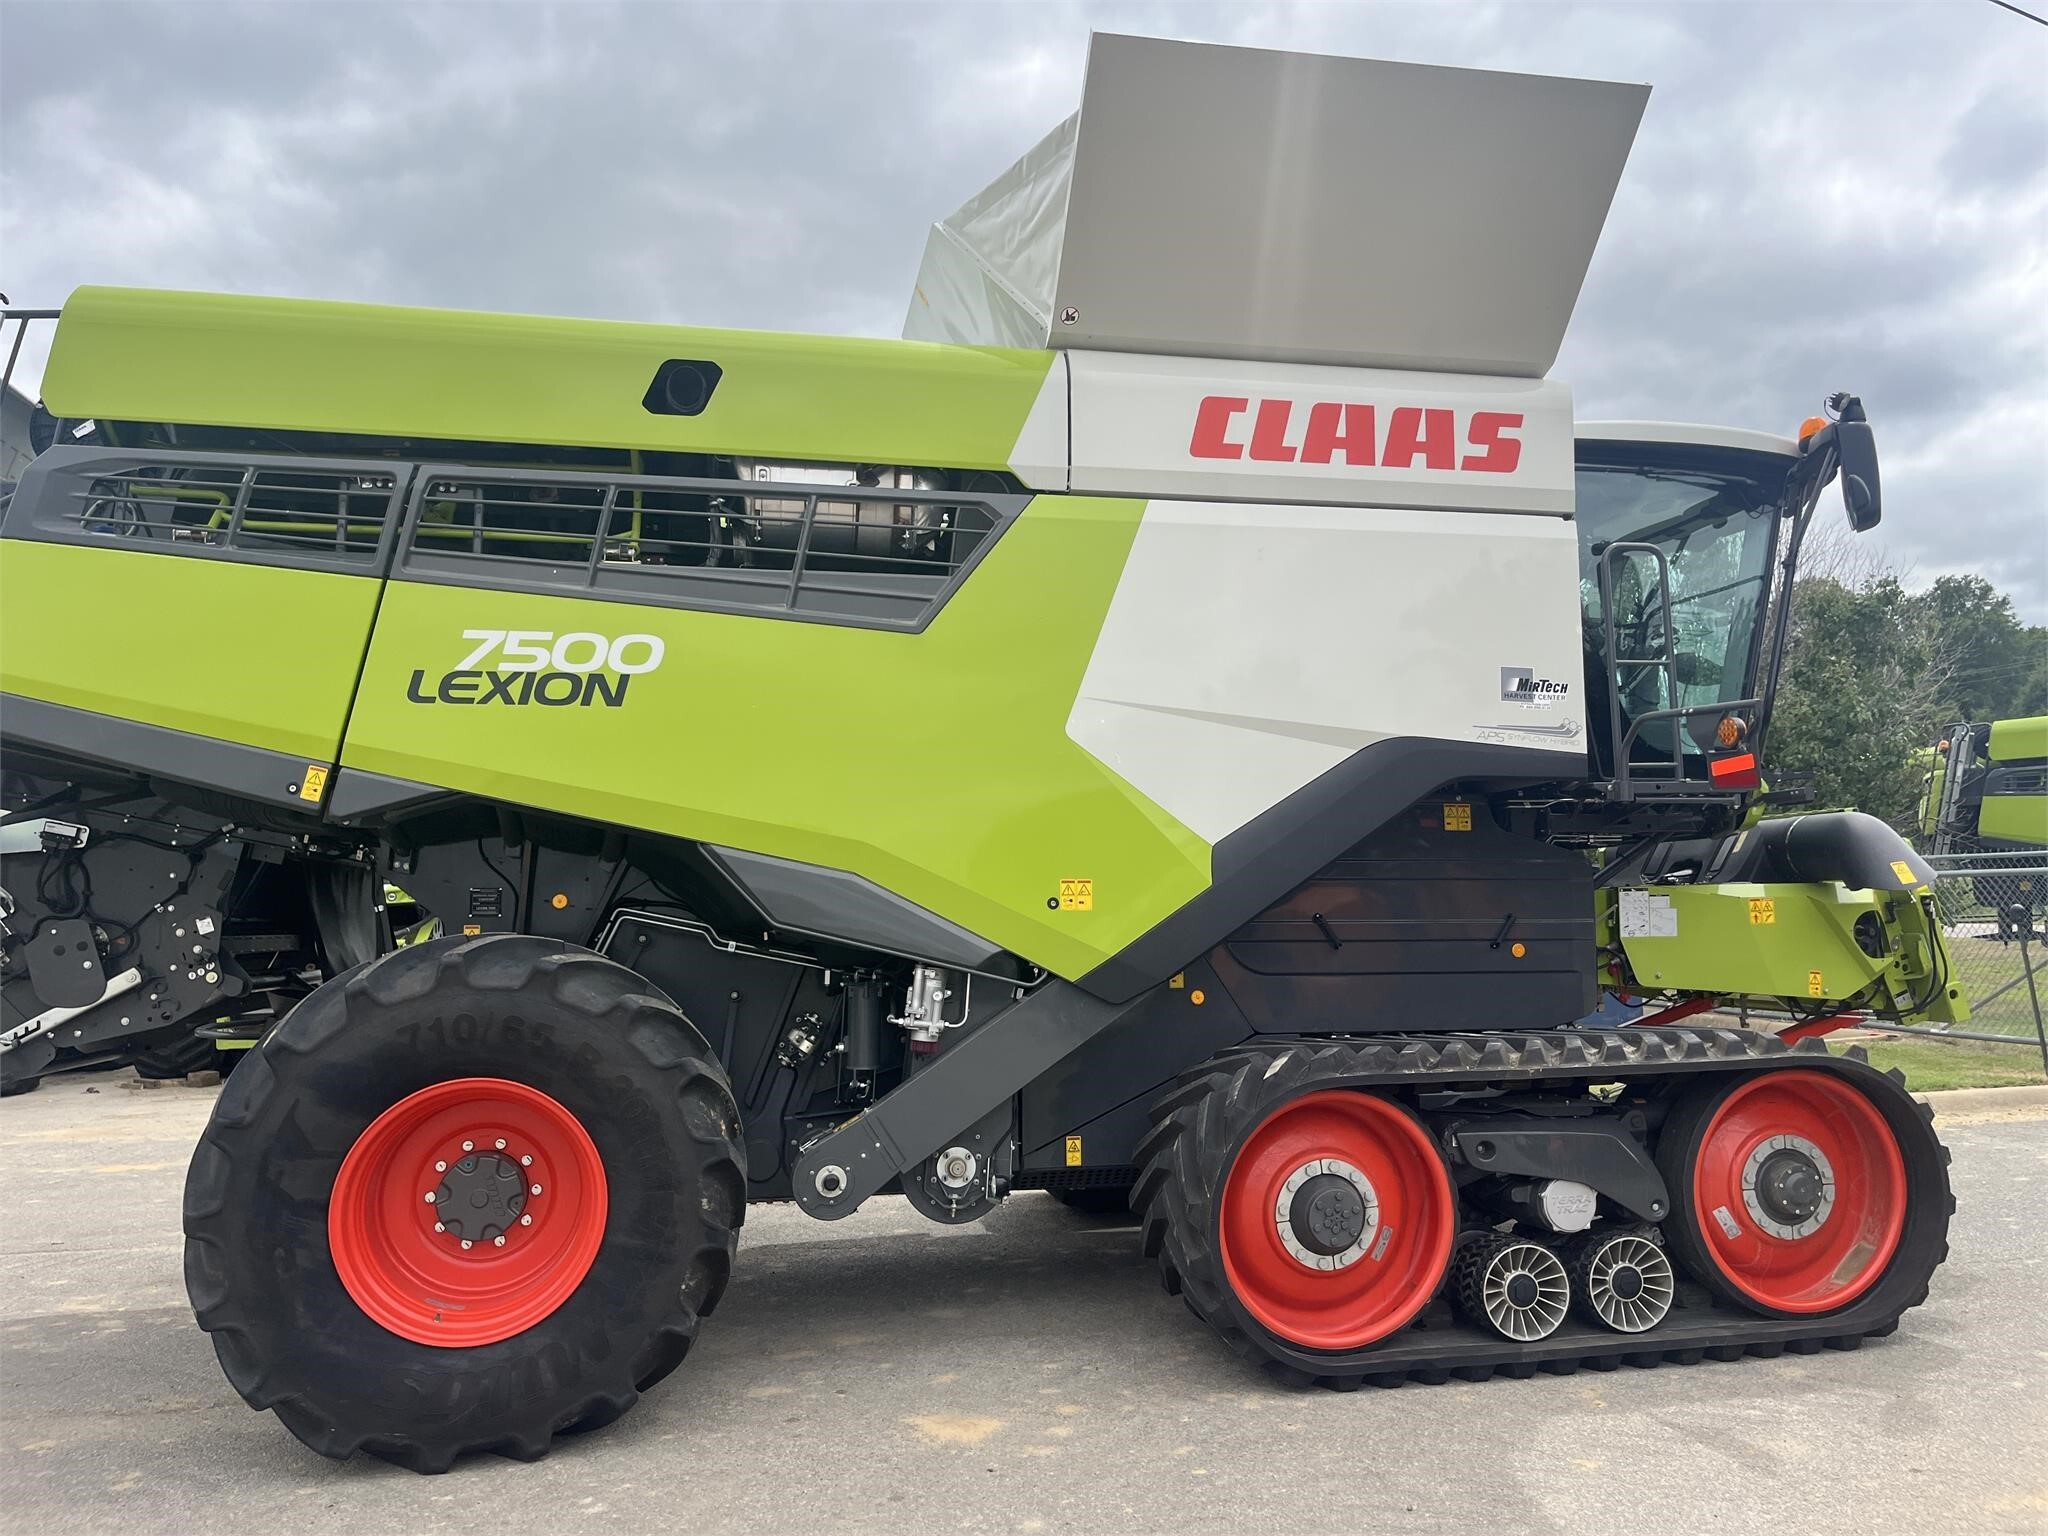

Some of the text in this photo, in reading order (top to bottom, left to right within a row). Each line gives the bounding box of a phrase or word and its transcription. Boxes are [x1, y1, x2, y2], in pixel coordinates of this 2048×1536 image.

[1189, 396, 1524, 473] CLAAS
[454, 630, 665, 675] 7500
[407, 669, 630, 707] LEXION
[1504, 692, 1536, 700] HARVEST
[1477, 731, 1504, 742] APS
[1552, 1195, 1592, 1206] TERRA
[1557, 1204, 1588, 1215] TRAC
